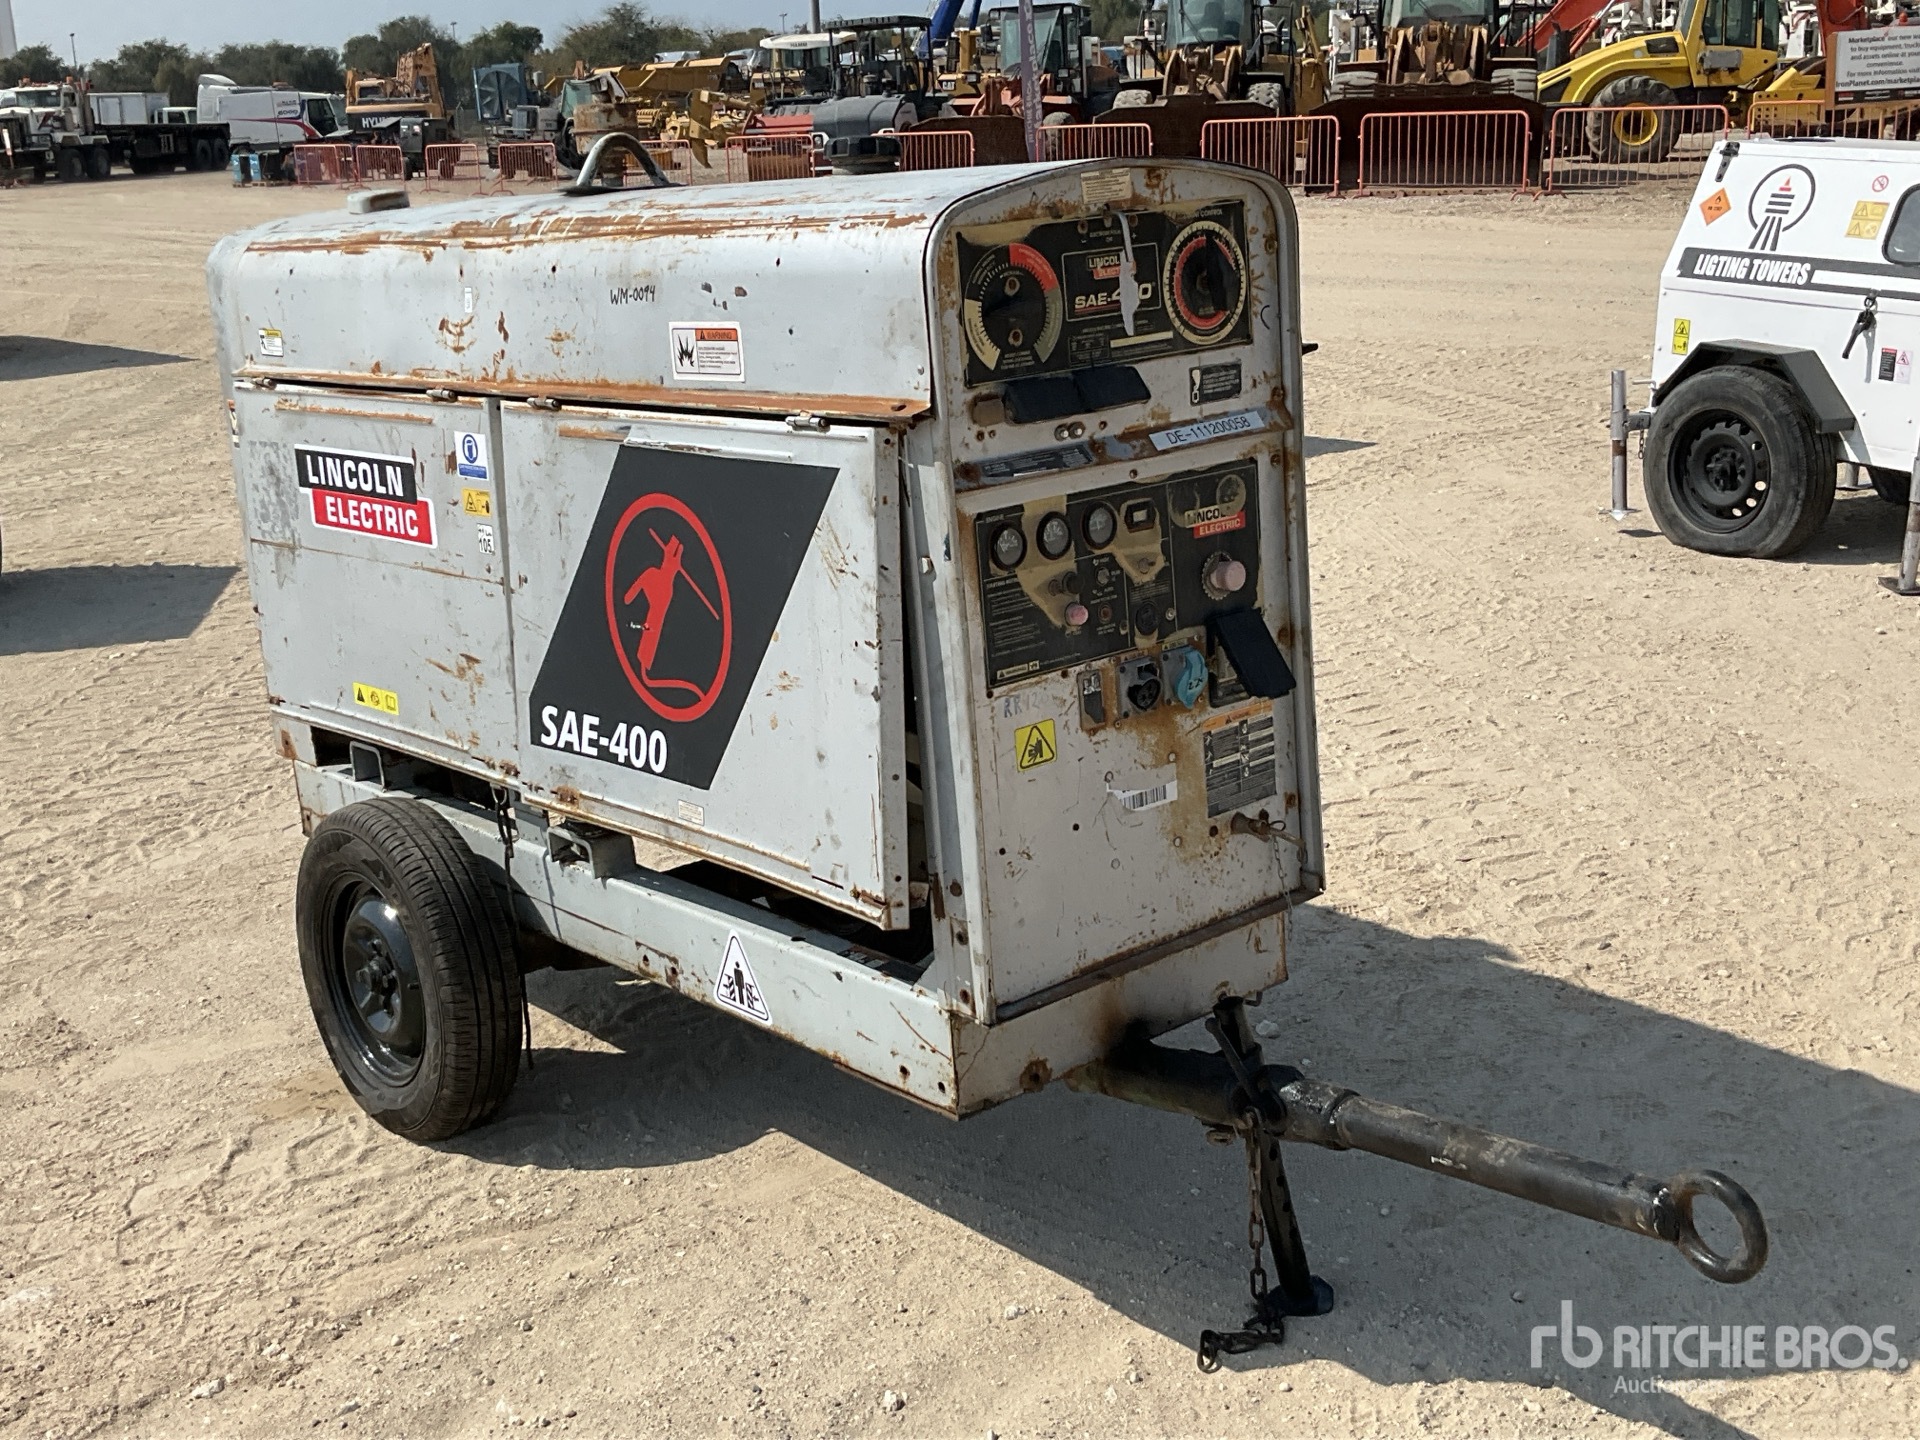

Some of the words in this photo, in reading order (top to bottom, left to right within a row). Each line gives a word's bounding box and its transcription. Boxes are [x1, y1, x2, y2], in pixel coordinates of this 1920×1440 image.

[1848, 36, 1885, 44] Marketplace
[943, 82, 955, 90] CAT
[1836, 77, 1920, 88] IronPlanet.com/marketpla
[1089, 255, 1120, 268] LINCOL
[1694, 255, 1751, 278] LIGTING
[1750, 259, 1811, 285] TOWERS
[610, 285, 656, 305] WM-0094
[707, 331, 732, 340] WARNING
[1165, 417, 1251, 445] DE-111200058
[306, 455, 404, 497] LINCOLN
[325, 496, 419, 537] ELECTRIC
[1199, 518, 1241, 536] ELECTRIC
[541, 705, 668, 773] SAE-400
